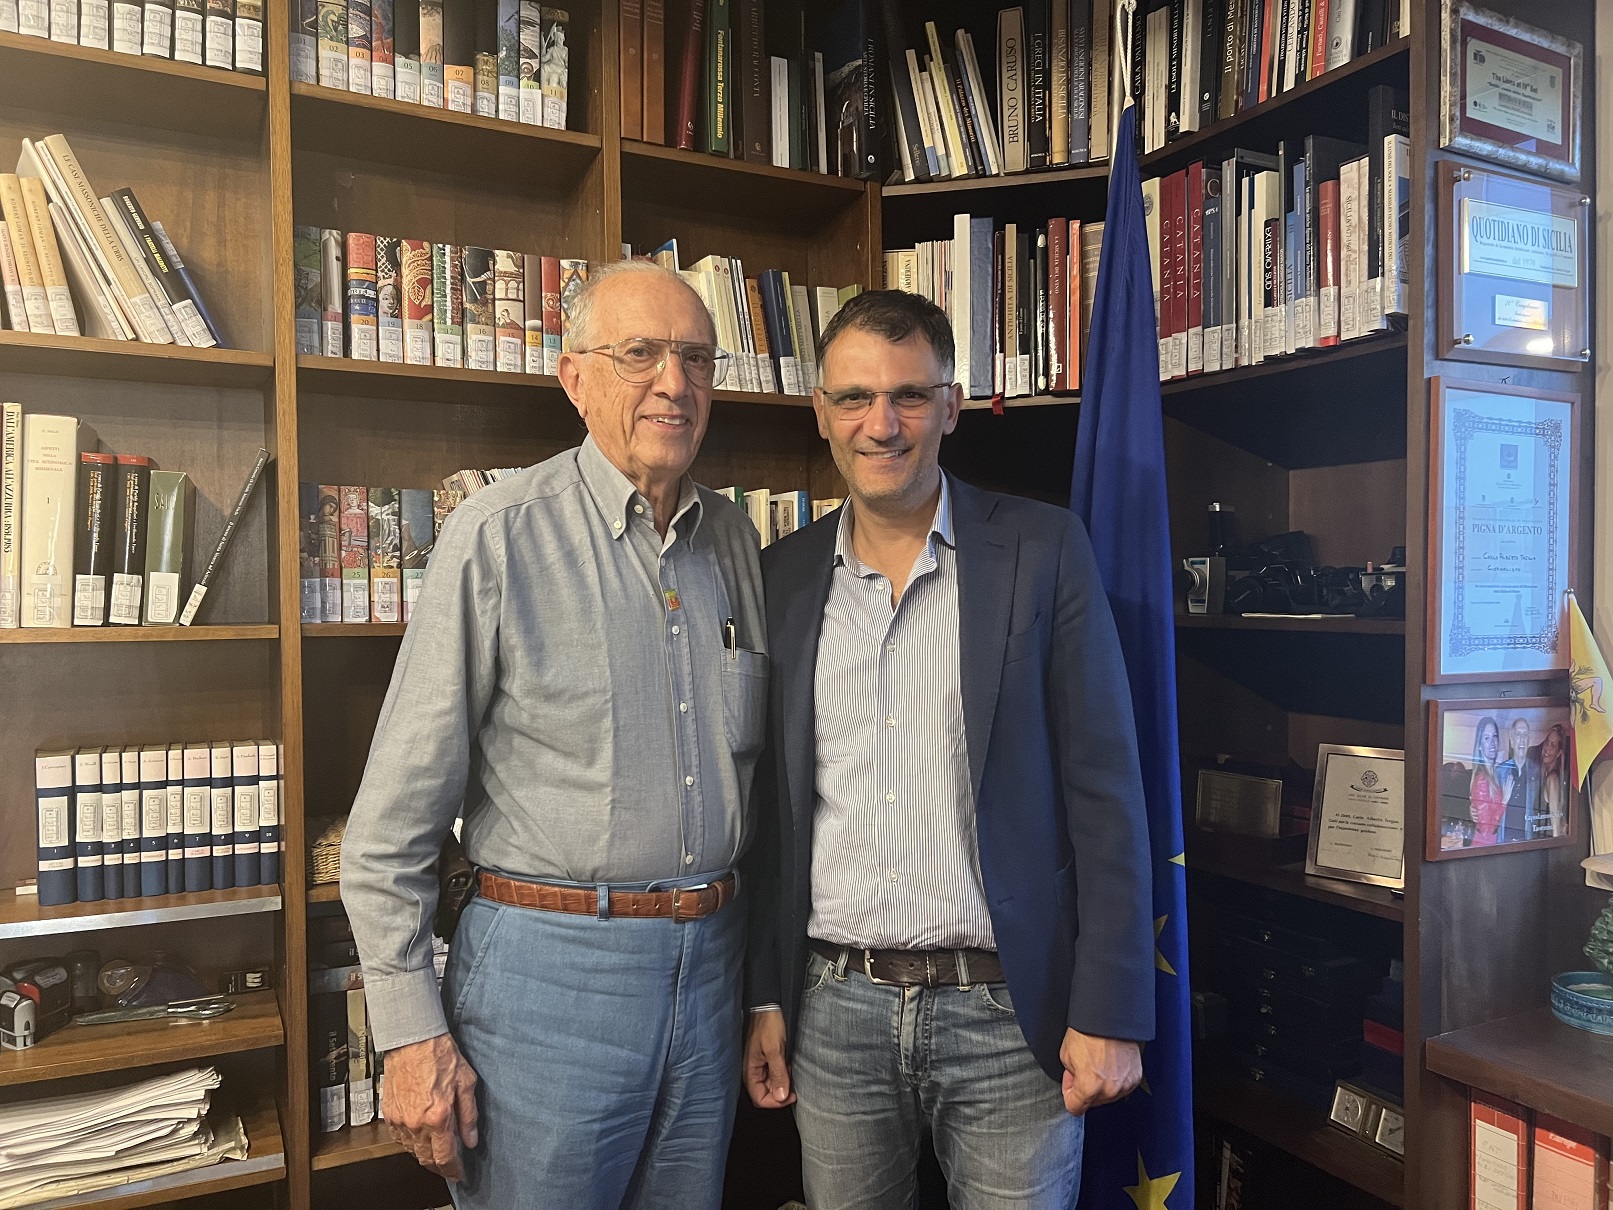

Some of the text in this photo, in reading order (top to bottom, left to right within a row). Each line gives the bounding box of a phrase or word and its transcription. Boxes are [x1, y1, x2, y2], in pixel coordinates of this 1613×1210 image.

[717, 30, 725, 80] Fontanarossa
[1035, 40, 1043, 70] GRECI
[1225, 22, 1234, 73] Il porto di
[1006, 37, 1019, 144] BRUNO CARUSO
[1035, 74, 1043, 85] IN
[1058, 29, 1066, 119] BISANZIO IN SICILIA
[1035, 89, 1043, 122] ITALIA
[63, 154, 123, 261] LE CASE MASSONICHE DELLA URBS
[15, 221, 24, 239] LOMAS
[22, 250, 33, 274] SEGRETO
[1054, 236, 1059, 244] LA
[1472, 216, 1573, 254] QUOTIDIANO DI SICILIA
[797, 310, 805, 344] MATTARELLA
[4, 411, 15, 519] DALL'AMERICA ALL'AZZURRA
[1472, 523, 1543, 535] PIGNA D'ARGENTO
[329, 1038, 337, 1081] Settecento
